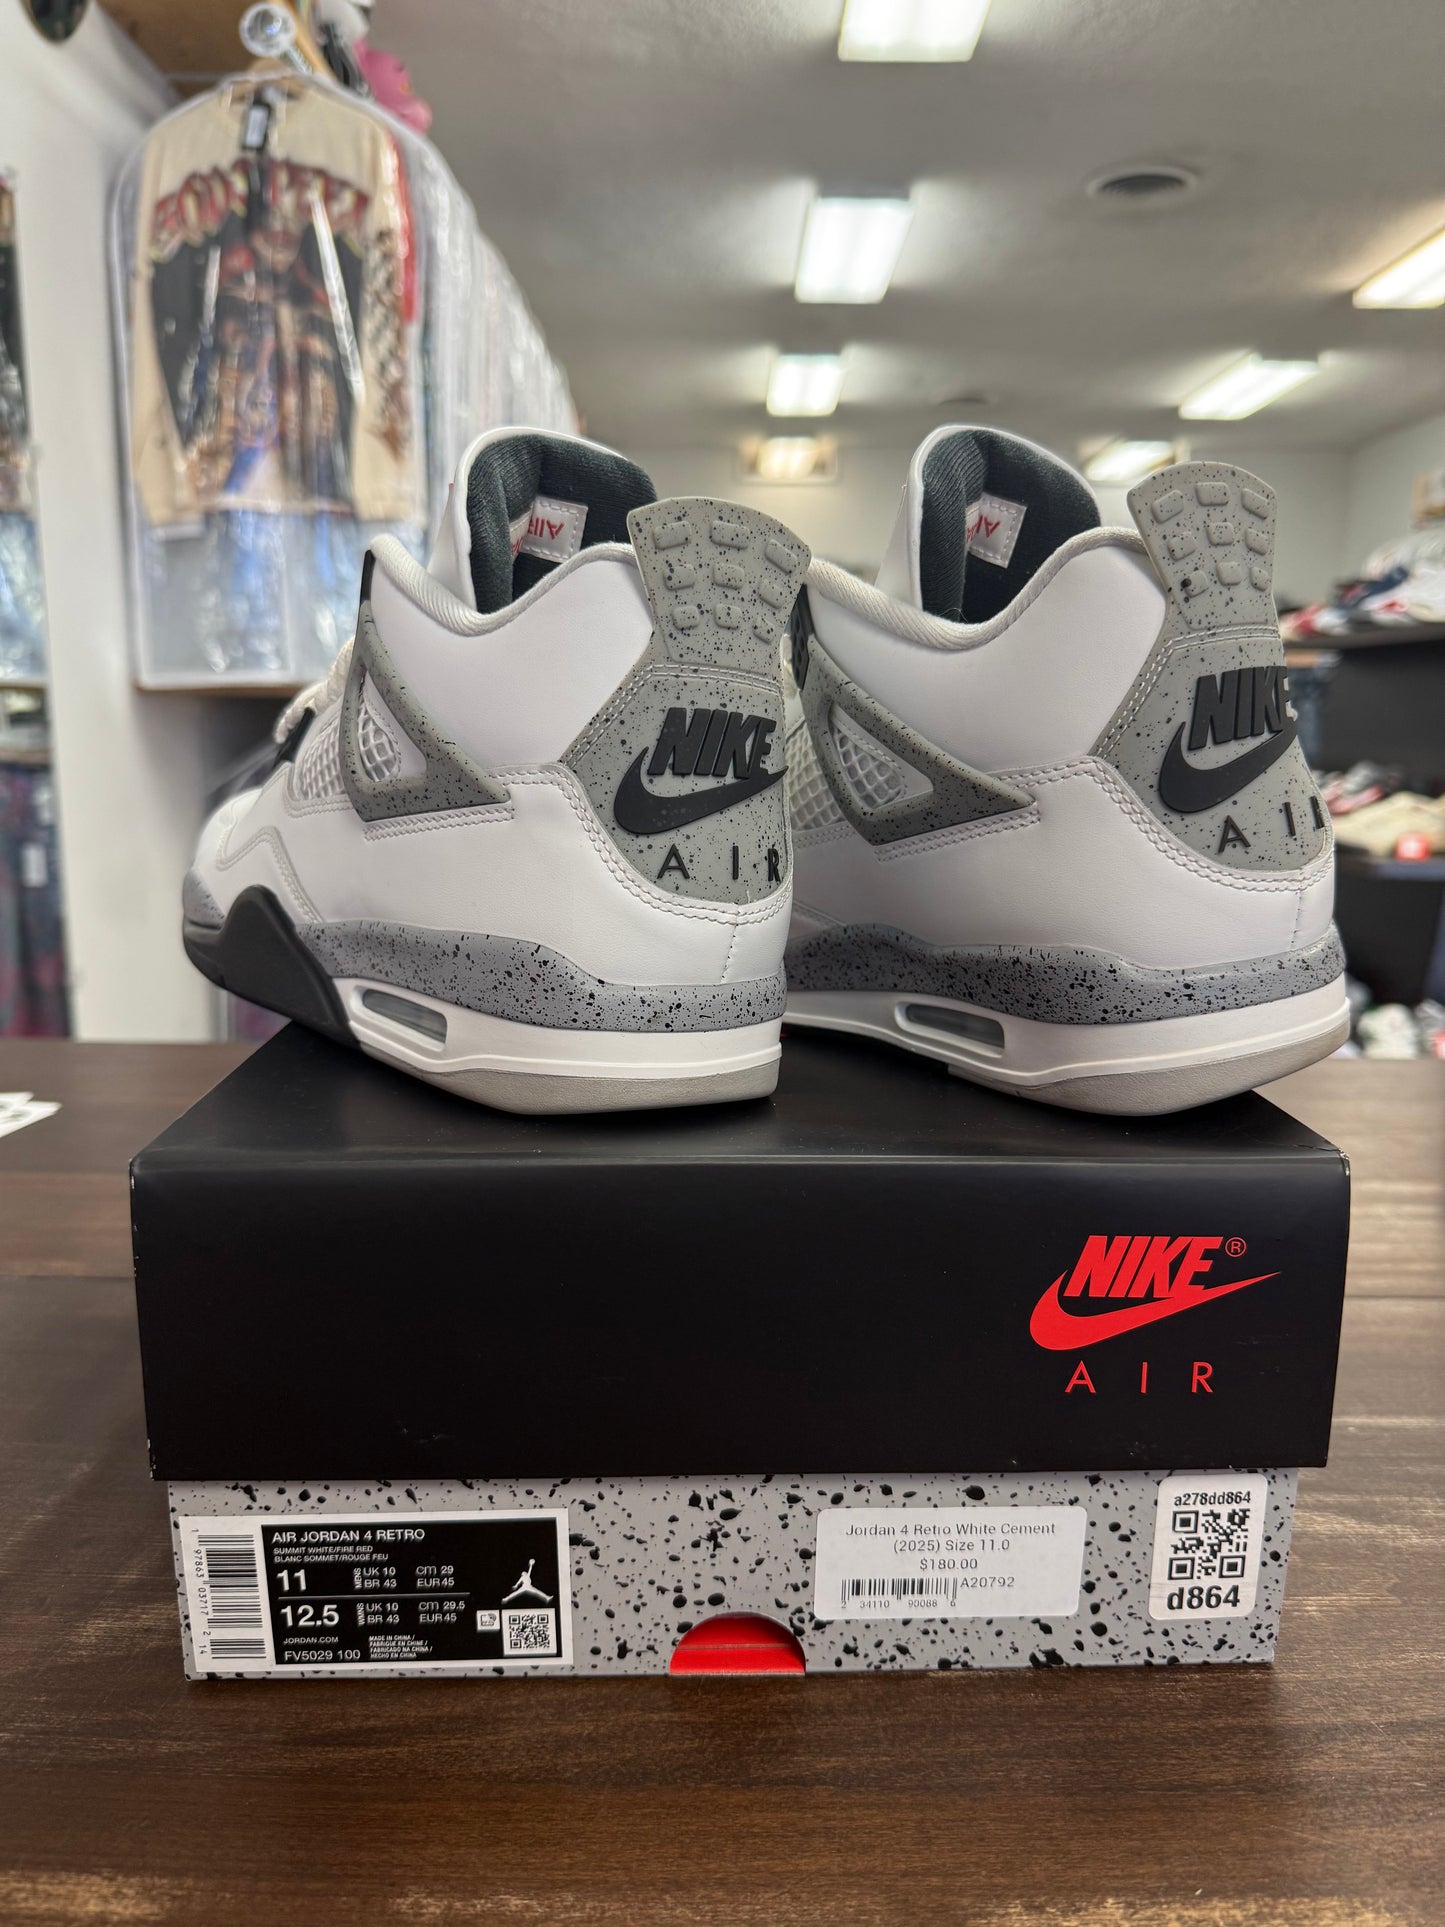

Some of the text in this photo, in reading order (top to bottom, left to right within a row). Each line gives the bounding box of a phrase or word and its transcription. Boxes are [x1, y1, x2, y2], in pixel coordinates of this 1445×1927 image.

[1188, 666, 1298, 751] NIKE
[647, 707, 777, 779] NIKE
[657, 843, 781, 882] AIR
[1063, 1235, 1224, 1298] NIKE
[1064, 1360, 1214, 1394] AIR
[1174, 1490, 1251, 1506] a278dd864
[846, 1523, 1055, 1536] Jordan 4 Retro White Cement
[272, 1529, 425, 1543] AIR JORDAN 4 RETRO
[274, 1545, 373, 1555] SUMMIT WHITE/FIRE RED
[893, 1539, 1010, 1553] (2025) Size 11.0
[193, 1549, 205, 1578] 97863
[274, 1553, 389, 1563] BLANC SOMMET/ROUGE FEU
[919, 1558, 978, 1570] $180.00
[363, 1566, 396, 1576] UK 10
[440, 1565, 454, 1575] 29
[276, 1569, 306, 1592] 11
[353, 1567, 362, 1589] MENS
[364, 1579, 397, 1588] BR 43
[417, 1577, 455, 1587] EUR 45
[960, 1576, 1015, 1588] A20792
[198, 1587, 209, 1616] 03717
[1167, 1585, 1240, 1610] d864
[366, 1602, 399, 1612] UK 10
[443, 1601, 466, 1610] 29.5
[841, 1600, 847, 1609] 2
[859, 1600, 890, 1608] 34110
[908, 1600, 938, 1608] 90088
[281, 1604, 340, 1627] 12.5
[356, 1602, 365, 1626] WMNS
[367, 1614, 400, 1624] BR 43
[419, 1613, 457, 1623] EUR 45
[283, 1636, 339, 1645] JORDAN.COM
[199, 1644, 207, 1654] 14
[284, 1649, 361, 1661] FV5029 100
